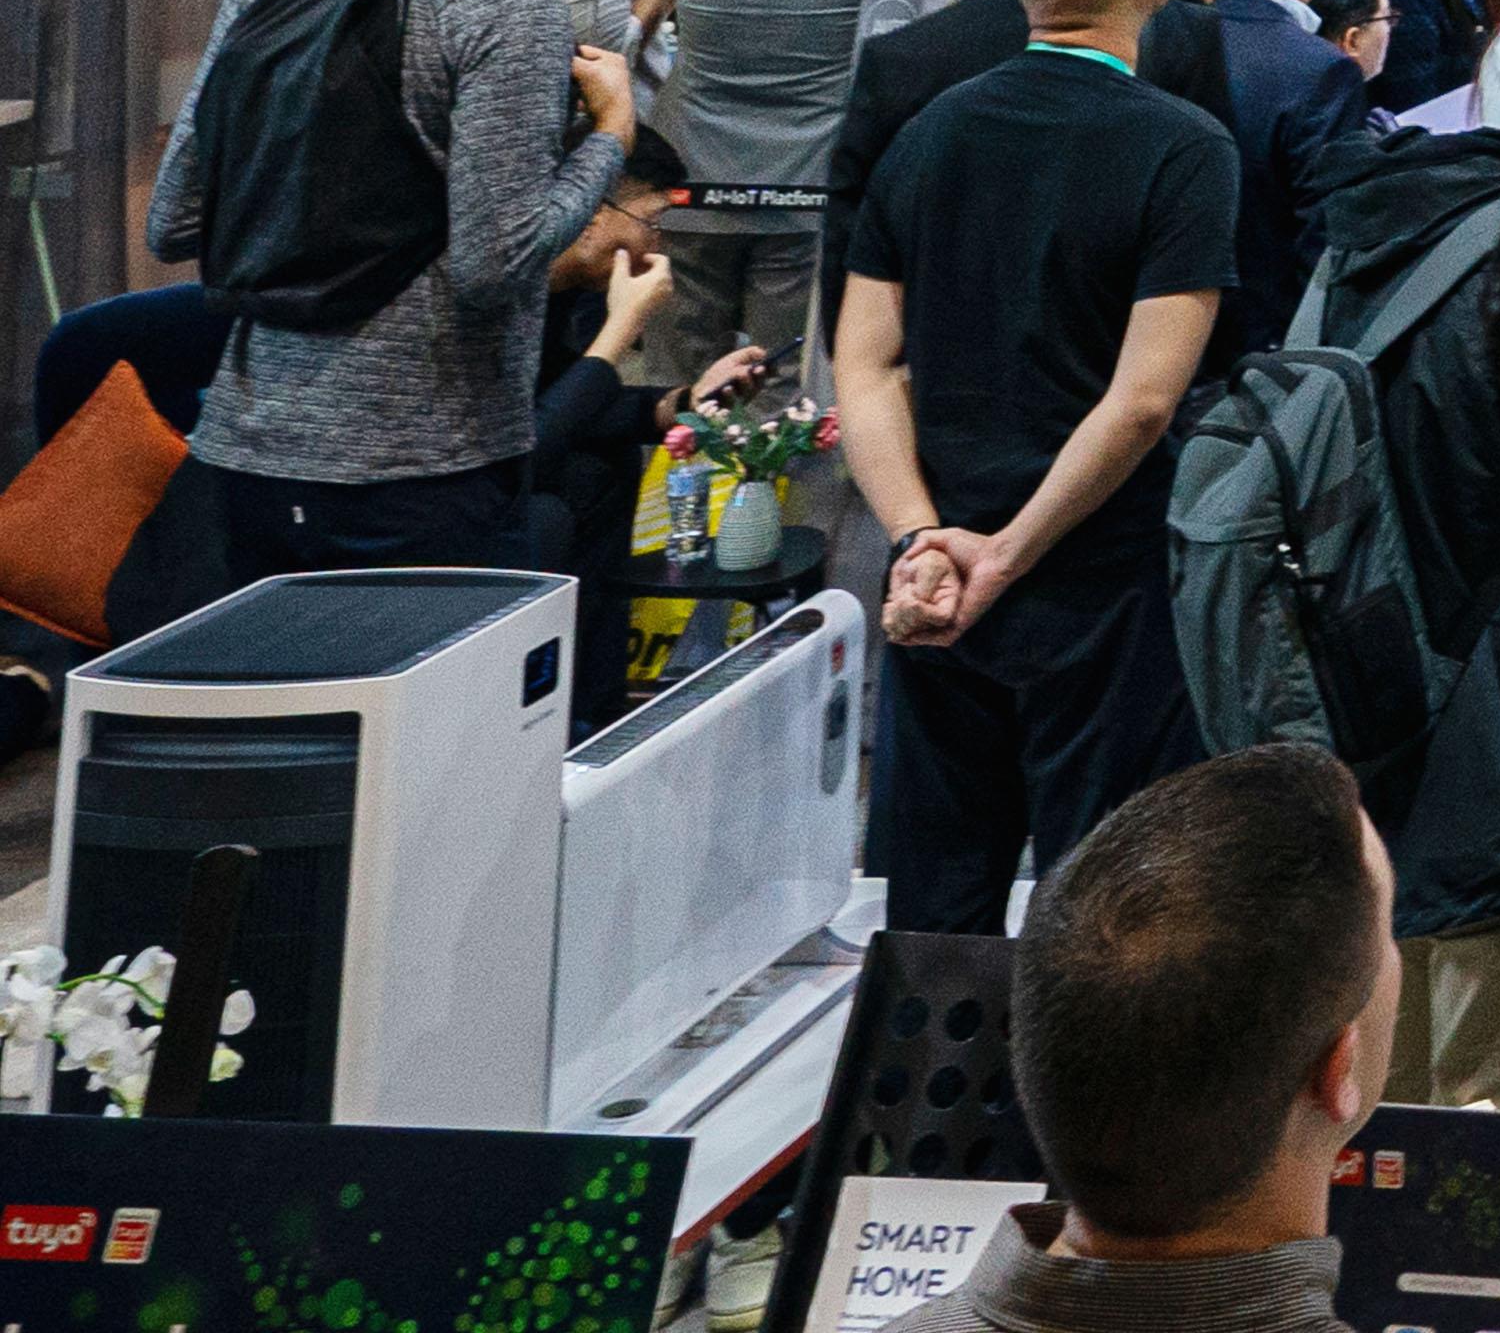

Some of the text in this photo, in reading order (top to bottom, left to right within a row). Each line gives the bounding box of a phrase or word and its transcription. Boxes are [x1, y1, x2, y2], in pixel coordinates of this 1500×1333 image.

[7, 1216, 86, 1253] tuya
[856, 1221, 976, 1253] SMART
[848, 1266, 946, 1298] HOME
